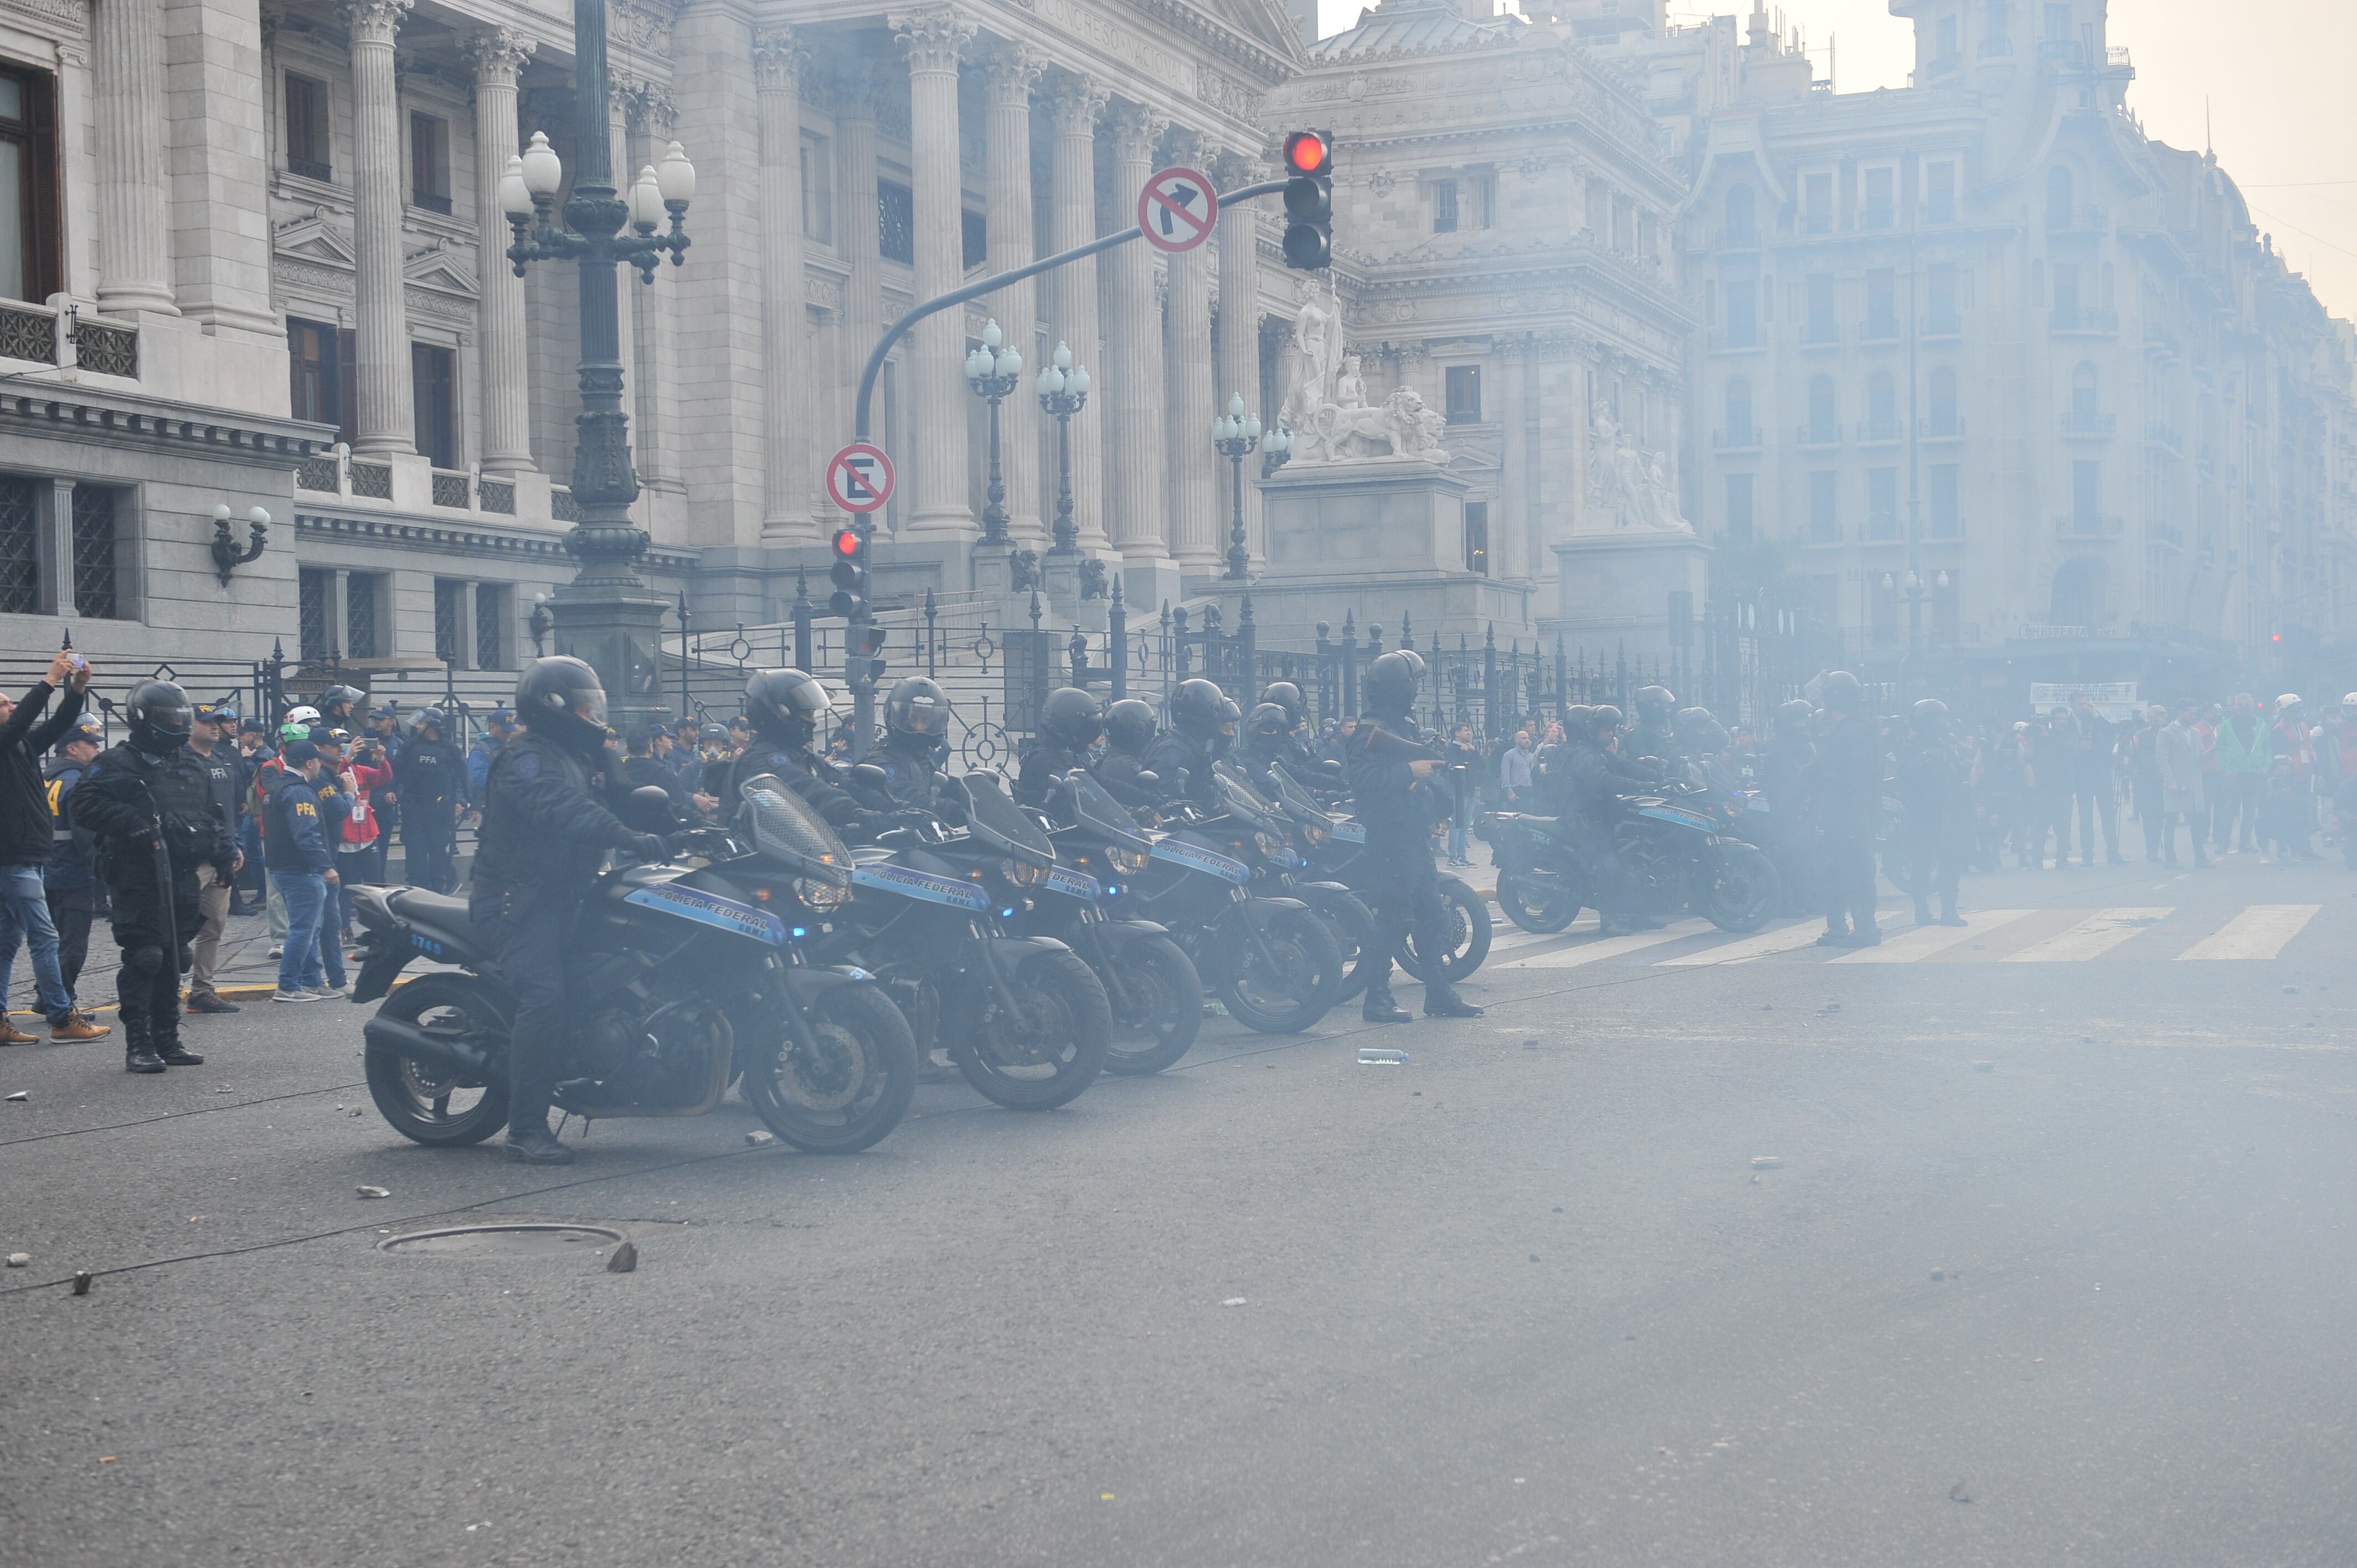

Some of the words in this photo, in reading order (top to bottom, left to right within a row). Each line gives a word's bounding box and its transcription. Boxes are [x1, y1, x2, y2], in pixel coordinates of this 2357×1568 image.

[847, 458, 875, 498] E
[419, 755, 438, 764] PFA
[210, 768, 228, 779] PFA
[317, 785, 336, 801] PFA
[295, 802, 317, 817] PFA
[1157, 843, 1196, 859] POLICIA
[1197, 855, 1241, 875] FEDERAL
[873, 868, 914, 886] POLICIA
[917, 880, 972, 899] FEDERAL
[1048, 872, 1089, 889] EDERAL
[657, 890, 703, 909] POLICIA
[706, 902, 768, 930] FEDERAL
